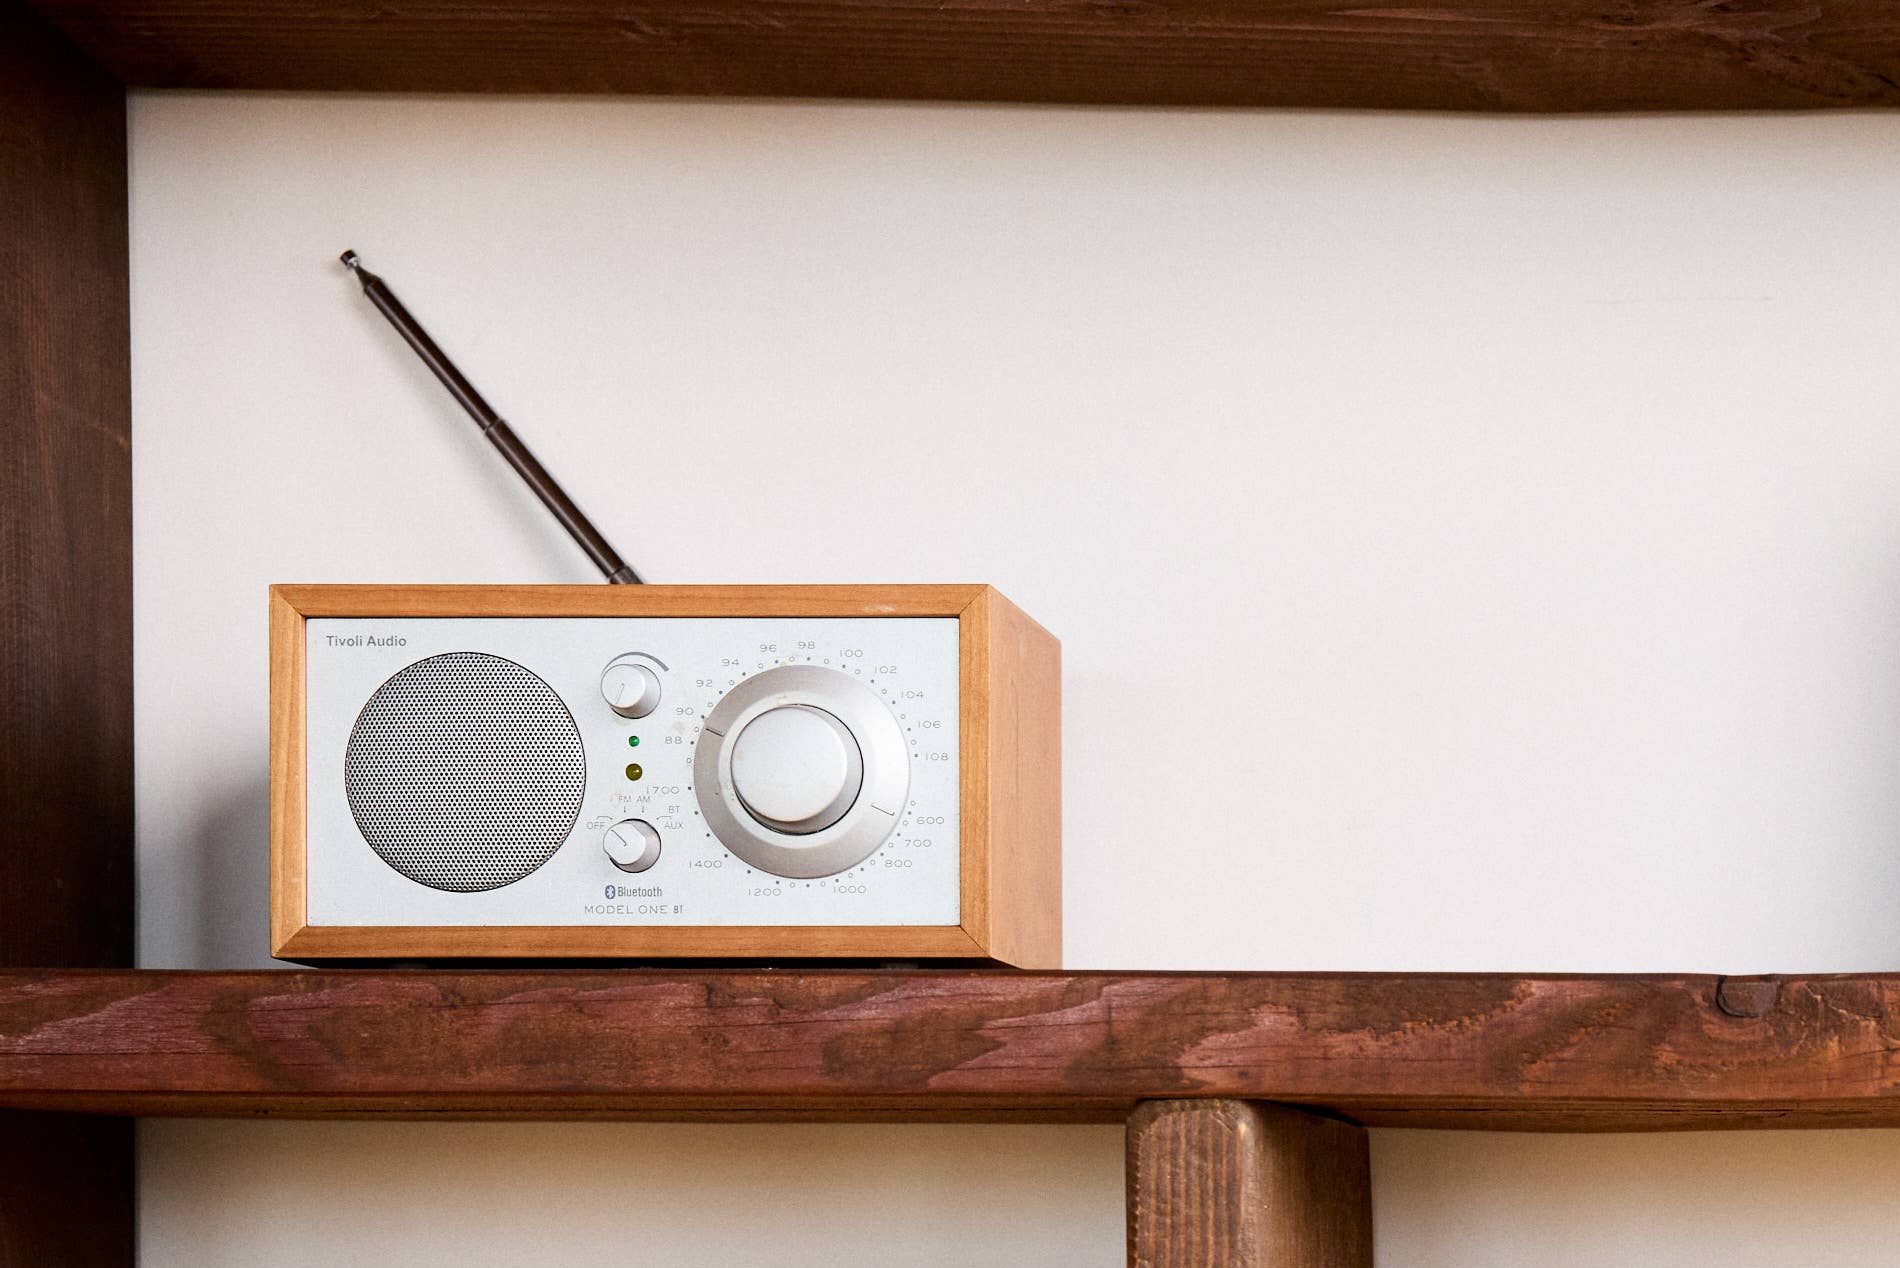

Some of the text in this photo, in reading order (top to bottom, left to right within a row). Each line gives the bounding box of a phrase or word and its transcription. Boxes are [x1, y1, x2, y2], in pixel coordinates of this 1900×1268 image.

[327, 635, 407, 647] Tivoli Audio
[798, 641, 815, 649] 98
[760, 644, 777, 652] 96
[839, 649, 863, 658] 100
[722, 659, 739, 667] 94
[874, 666, 897, 674] 102
[696, 679, 713, 687] 92
[901, 690, 924, 699] 104
[676, 707, 694, 716] 90
[918, 720, 941, 728] 106
[665, 736, 682, 745] 88
[925, 752, 949, 761] 108
[646, 787, 679, 795] 1700
[636, 795, 650, 803] AM
[917, 816, 944, 825] 600
[905, 839, 931, 847] 700
[689, 860, 722, 868] 1400
[885, 859, 912, 868] 800
[617, 887, 662, 897] Bluetooth
[748, 888, 781, 896] 1200
[833, 885, 867, 894] 1000
[584, 905, 684, 914] MODEL ONE BT
